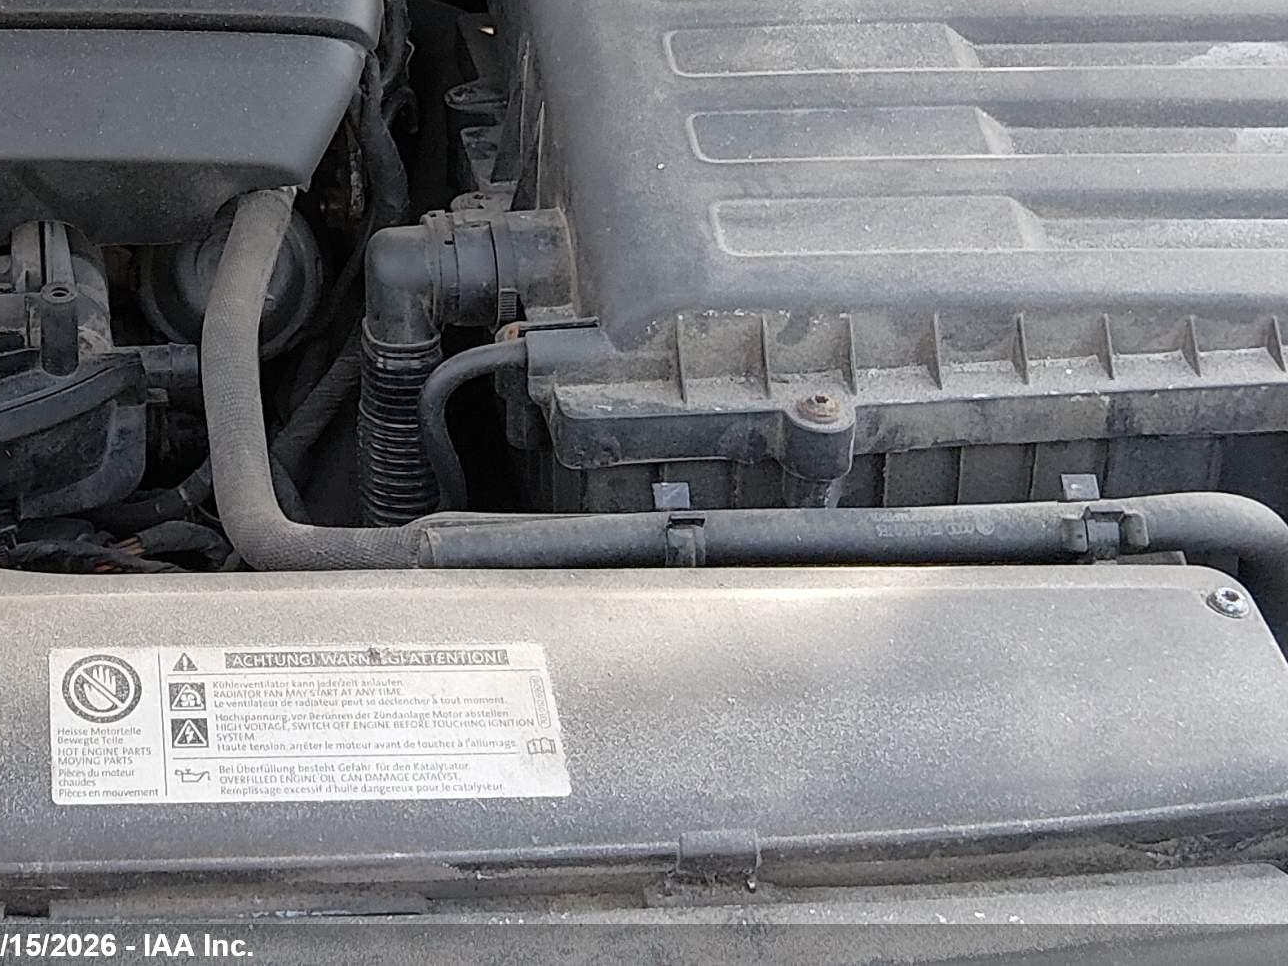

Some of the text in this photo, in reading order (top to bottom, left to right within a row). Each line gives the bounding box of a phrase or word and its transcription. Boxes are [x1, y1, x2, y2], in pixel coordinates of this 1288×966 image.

[292, 680, 314, 688] kann
[214, 690, 261, 698] RADIATOR
[264, 689, 283, 698] FAN
[286, 689, 307, 698] MAY
[309, 688, 338, 697] START
[340, 688, 352, 696] AT
[356, 688, 376, 696] ANY
[214, 700, 224, 708] Le
[226, 699, 278, 707] ventilateur
[280, 698, 292, 707] de
[295, 697, 338, 707] radiateur
[342, 698, 364, 708] peut
[354, 711, 370, 720] der
[432, 710, 462, 719] Motor
[292, 722, 330, 730] SWITCH
[332, 721, 350, 730] OFF
[353, 720, 390, 730] ENGINE
[393, 720, 428, 729] BEFORE
[432, 720, 486, 728] TOUCHING
[488, 718, 534, 728] IGNITION
[57, 746, 152, 756] HOT ENGINE PARTS
[217, 742, 247, 752] Haute
[324, 740, 334, 750] le
[336, 741, 371, 750] moteur
[374, 740, 401, 748] avant
[403, 740, 416, 748] de
[418, 740, 455, 748] toucher
[57, 756, 134, 766] MOVING PARTS
[88, 768, 100, 777] du
[101, 769, 135, 777] moteur
[218, 764, 234, 774] Bei
[298, 762, 335, 773] besteht
[338, 762, 371, 772] Gefahr
[376, 762, 390, 772] für
[392, 762, 410, 771] den
[58, 778, 96, 787] chaudes
[219, 774, 277, 784] OVERFILLED
[280, 774, 318, 784] ENGINE
[320, 774, 336, 783] OIL
[340, 773, 362, 782] CAN
[364, 773, 409, 782] DAMAGE
[88, 790, 100, 798] en
[102, 788, 158, 797] mouvement
[284, 784, 322, 794] excessif
[360, 784, 413, 794] dangereux
[416, 784, 438, 794] pour
[442, 782, 450, 792] le
